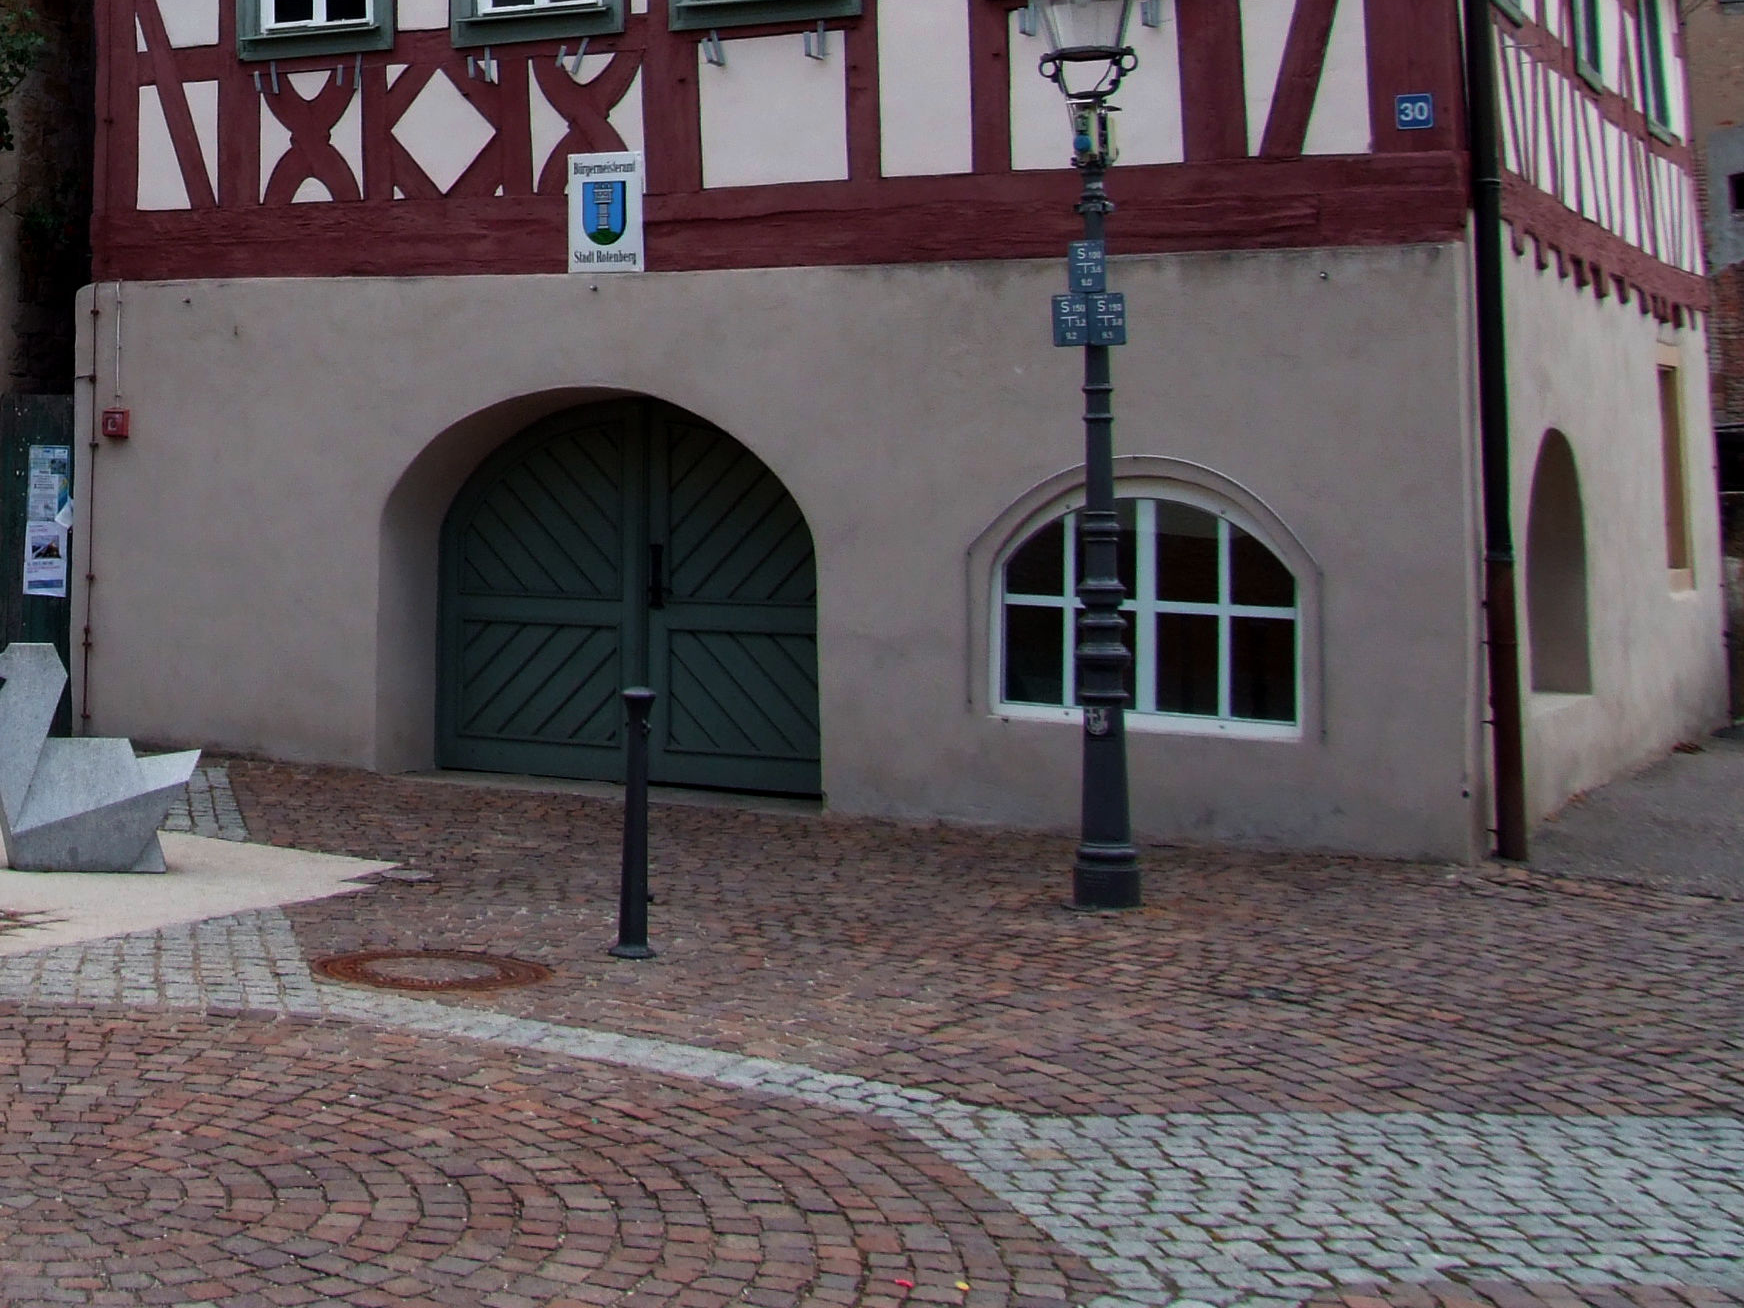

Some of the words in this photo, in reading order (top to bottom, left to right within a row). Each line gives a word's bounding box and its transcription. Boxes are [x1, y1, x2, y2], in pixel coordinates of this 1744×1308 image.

[1400, 102, 1428, 121] 30
[573, 161, 635, 177] Bürgermeisteramt
[574, 250, 595, 264] Stadt
[596, 249, 637, 265] Rotenberg
[1076, 248, 1086, 259] S
[1060, 301, 1070, 313] S
[1096, 300, 1106, 312] S
